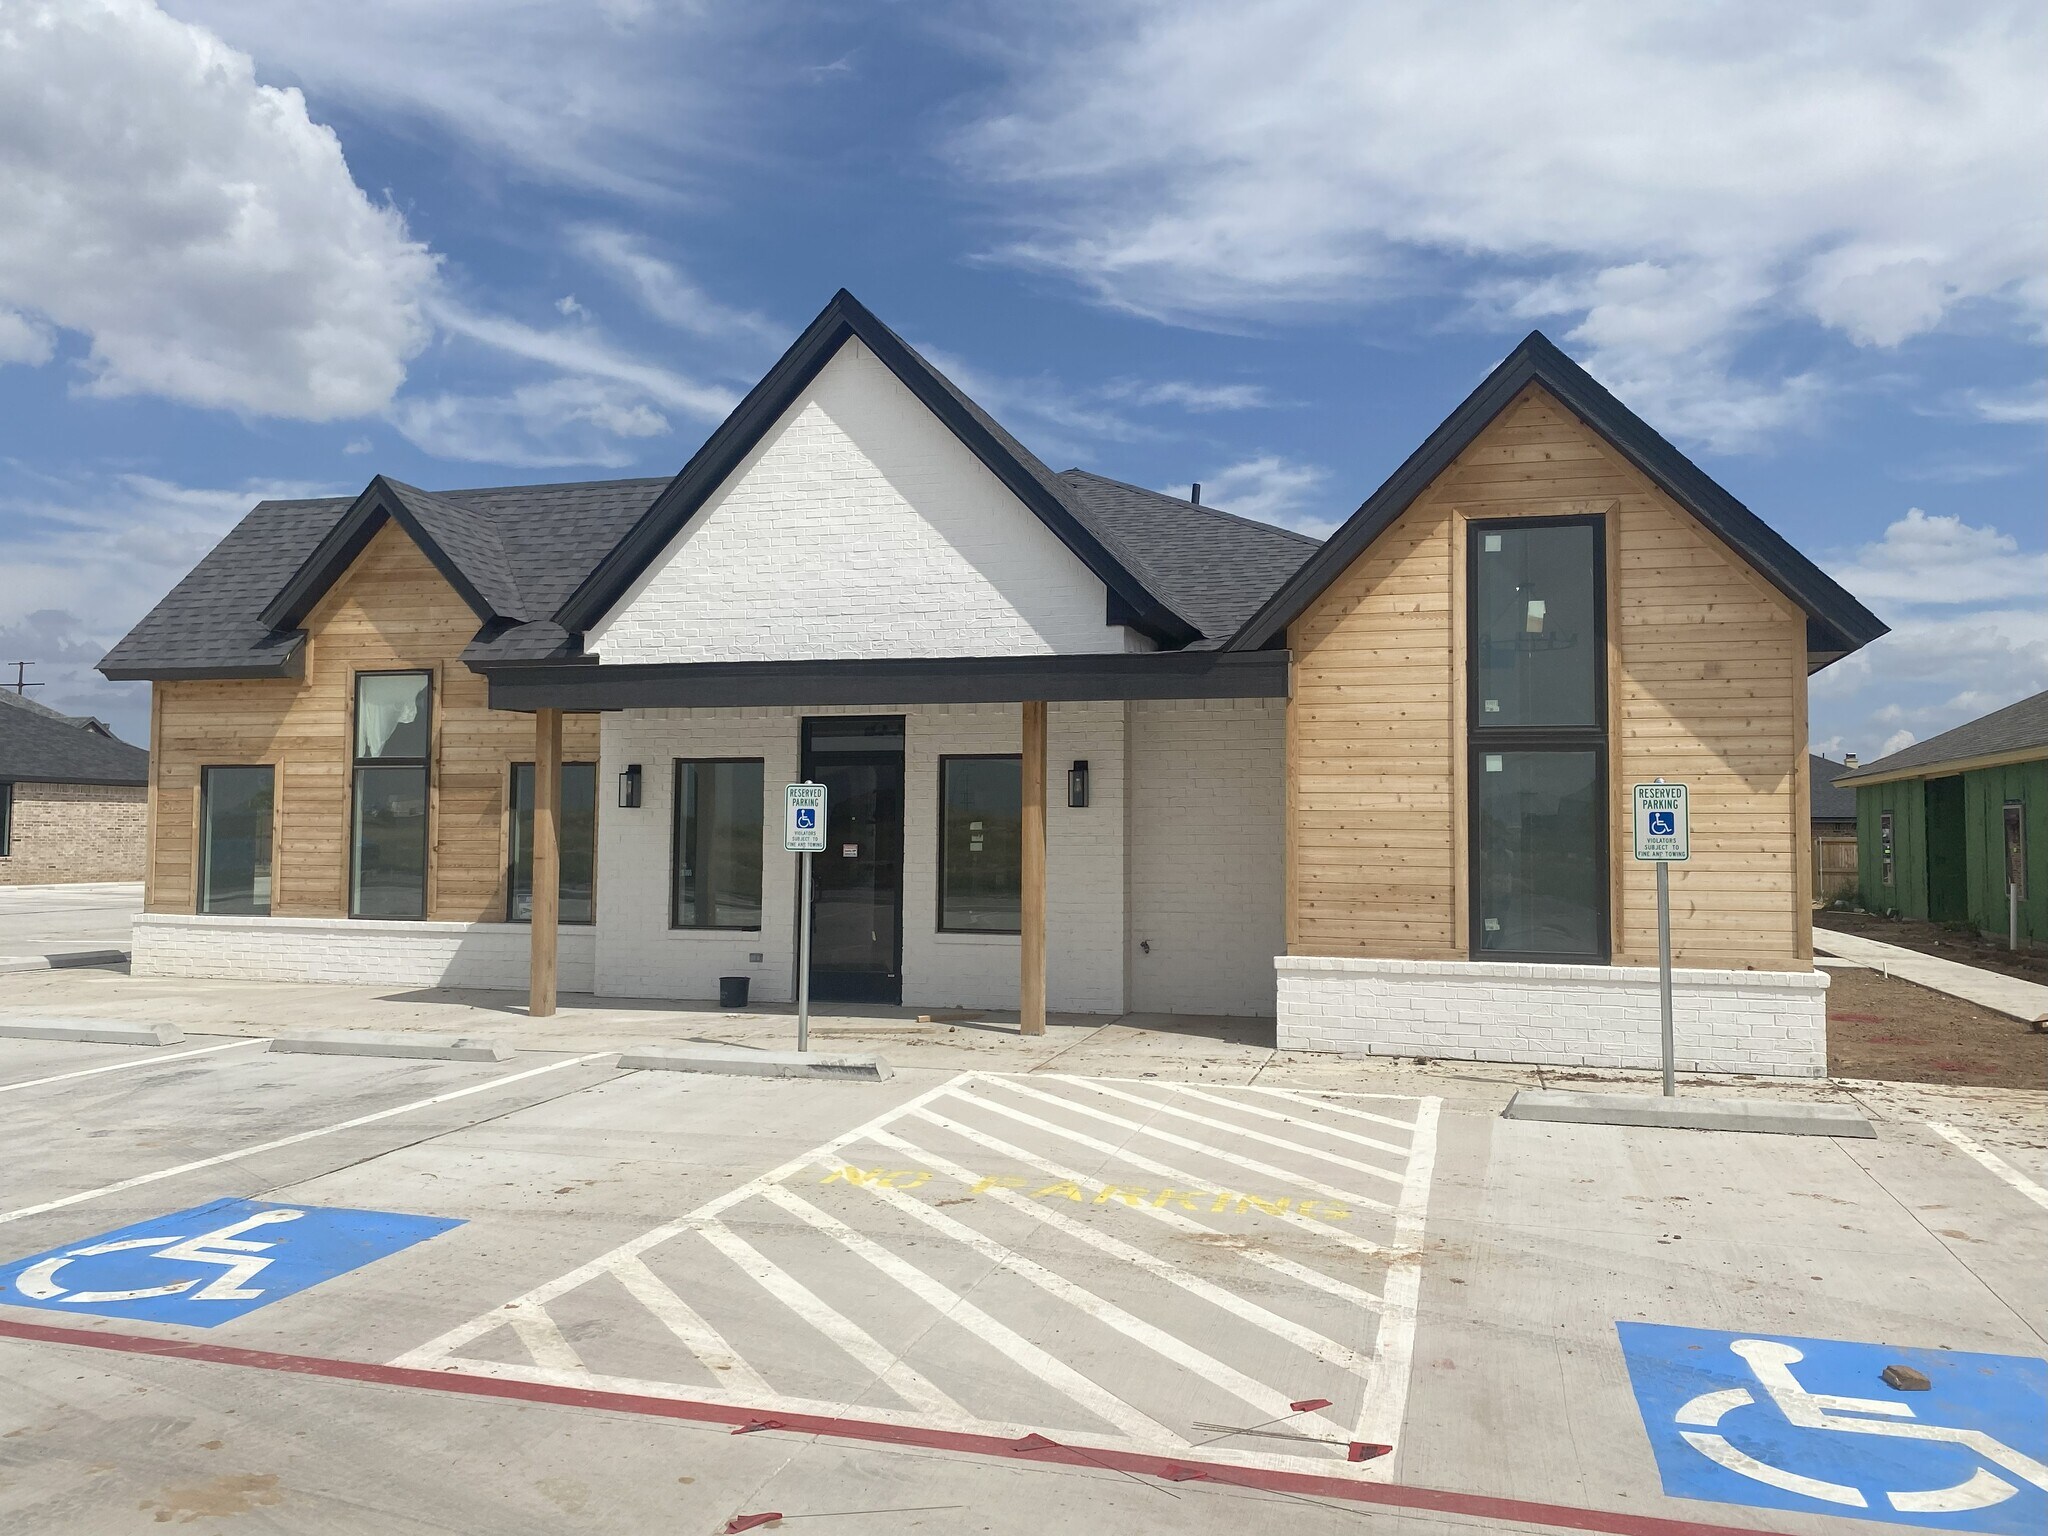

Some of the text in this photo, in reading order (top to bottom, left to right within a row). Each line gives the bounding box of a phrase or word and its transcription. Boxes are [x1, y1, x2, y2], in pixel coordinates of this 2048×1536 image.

[789, 788, 822, 798] RESERVED
[1638, 788, 1682, 798] RESERVED
[792, 798, 819, 807] PARKING
[1642, 799, 1679, 810] PARKING
[820, 1165, 1351, 1221] NO PARKING
